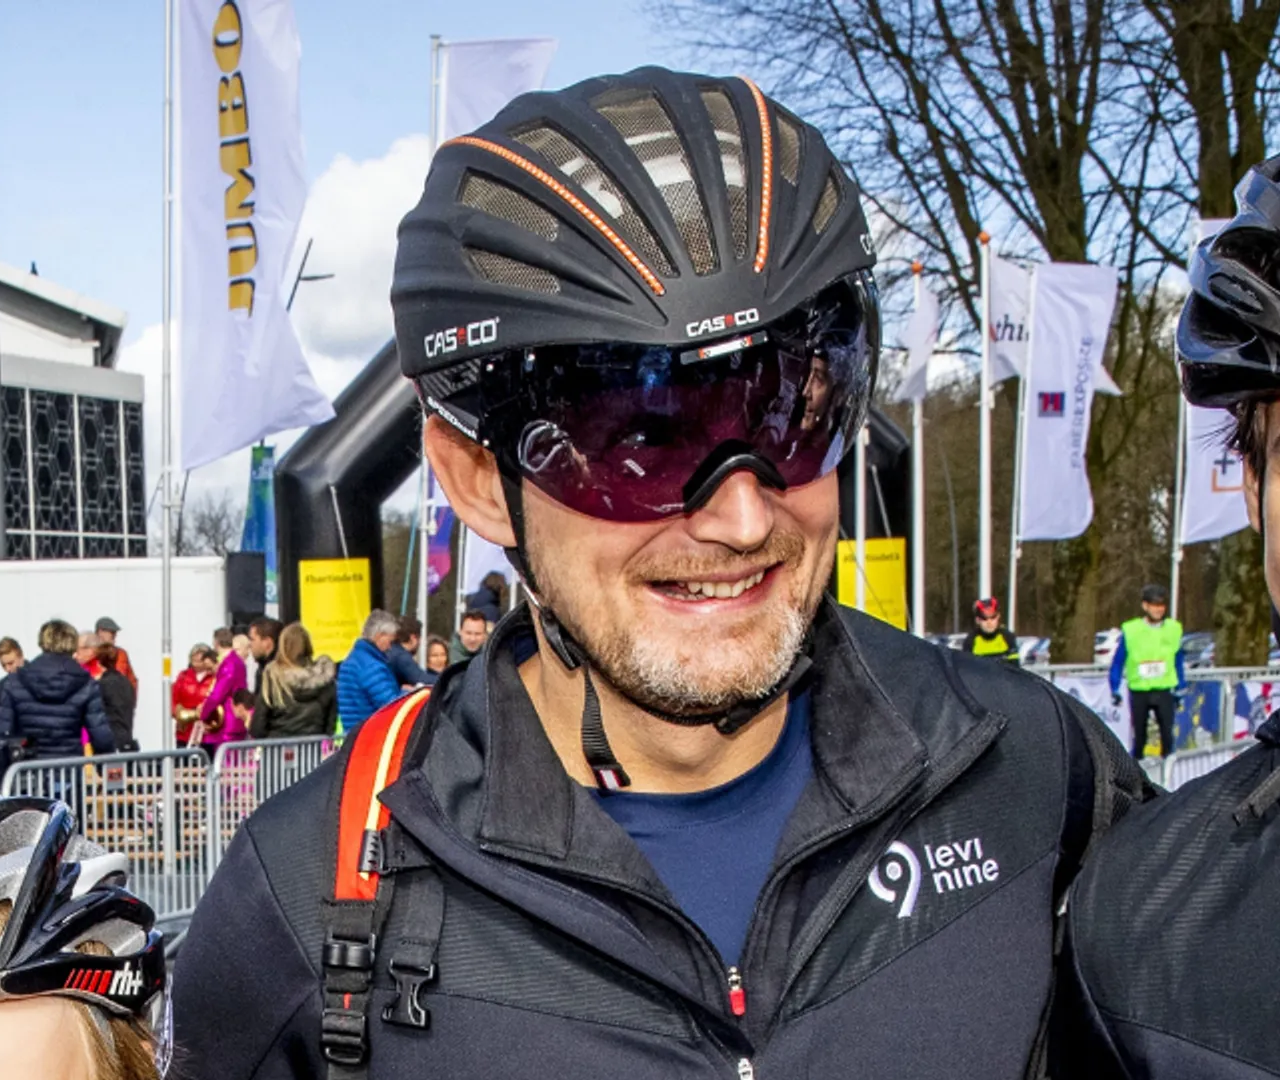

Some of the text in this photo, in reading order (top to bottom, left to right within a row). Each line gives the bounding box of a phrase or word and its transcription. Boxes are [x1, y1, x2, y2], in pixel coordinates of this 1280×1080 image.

[212, 0, 259, 318] JUMBO
[995, 314, 1030, 342] thi
[924, 838, 983, 870] levi
[933, 859, 999, 894] nine
